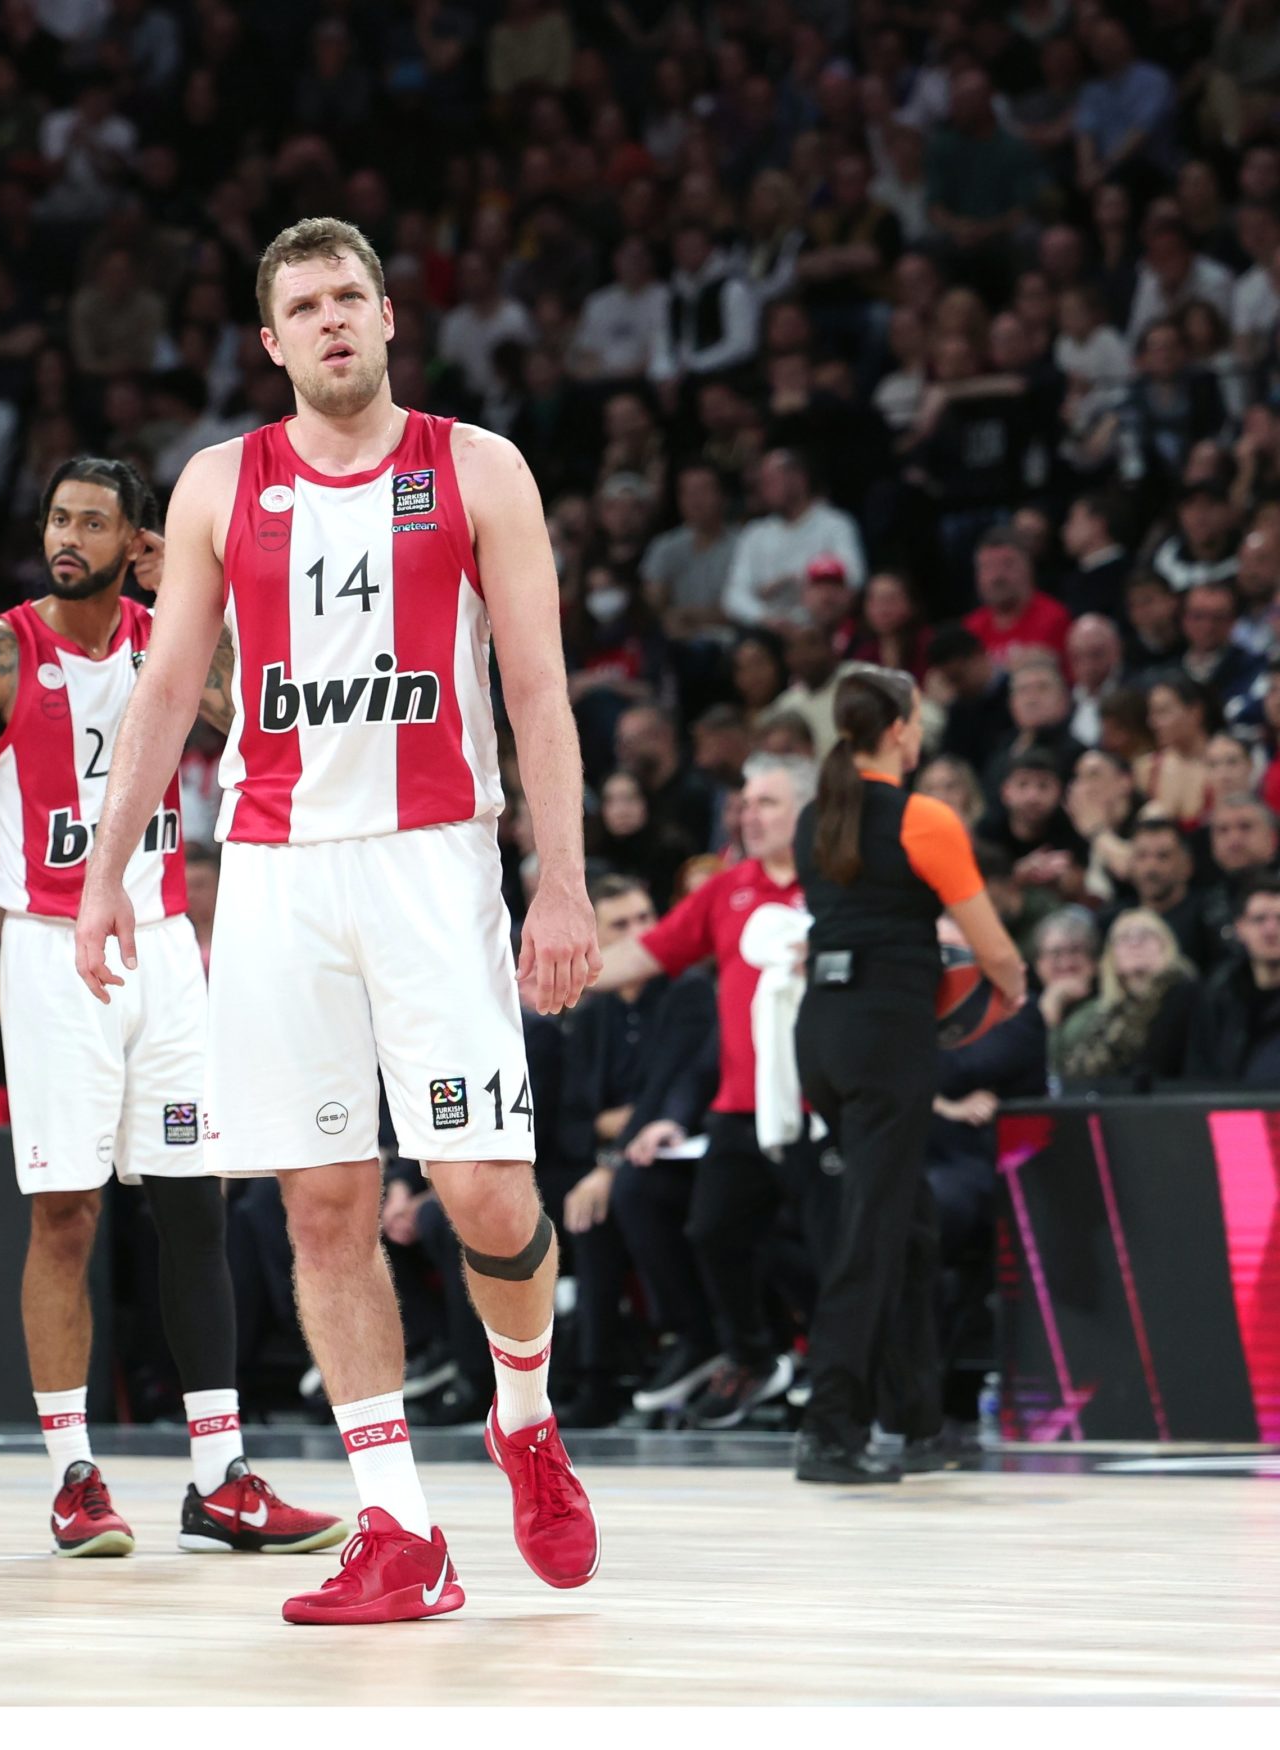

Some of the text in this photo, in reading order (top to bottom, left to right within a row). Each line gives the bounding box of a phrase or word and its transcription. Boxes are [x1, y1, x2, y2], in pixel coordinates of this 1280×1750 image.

[397, 473, 430, 493] 25
[397, 492, 429, 502] TURKISH
[397, 498, 430, 507] AIRLINES
[392, 522, 437, 532] oneteam
[305, 550, 380, 617] 14
[261, 652, 438, 731] bwin
[49, 811, 178, 864] bin
[431, 1079, 465, 1105] 25
[482, 1068, 533, 1133] 14
[318, 1112, 348, 1122] GSA
[434, 1105, 465, 1116] TURKISH
[435, 1112, 465, 1122] AIRLINES
[52, 1415, 79, 1427] GS
[195, 1416, 239, 1434] GSA
[348, 1423, 407, 1447] GSA
